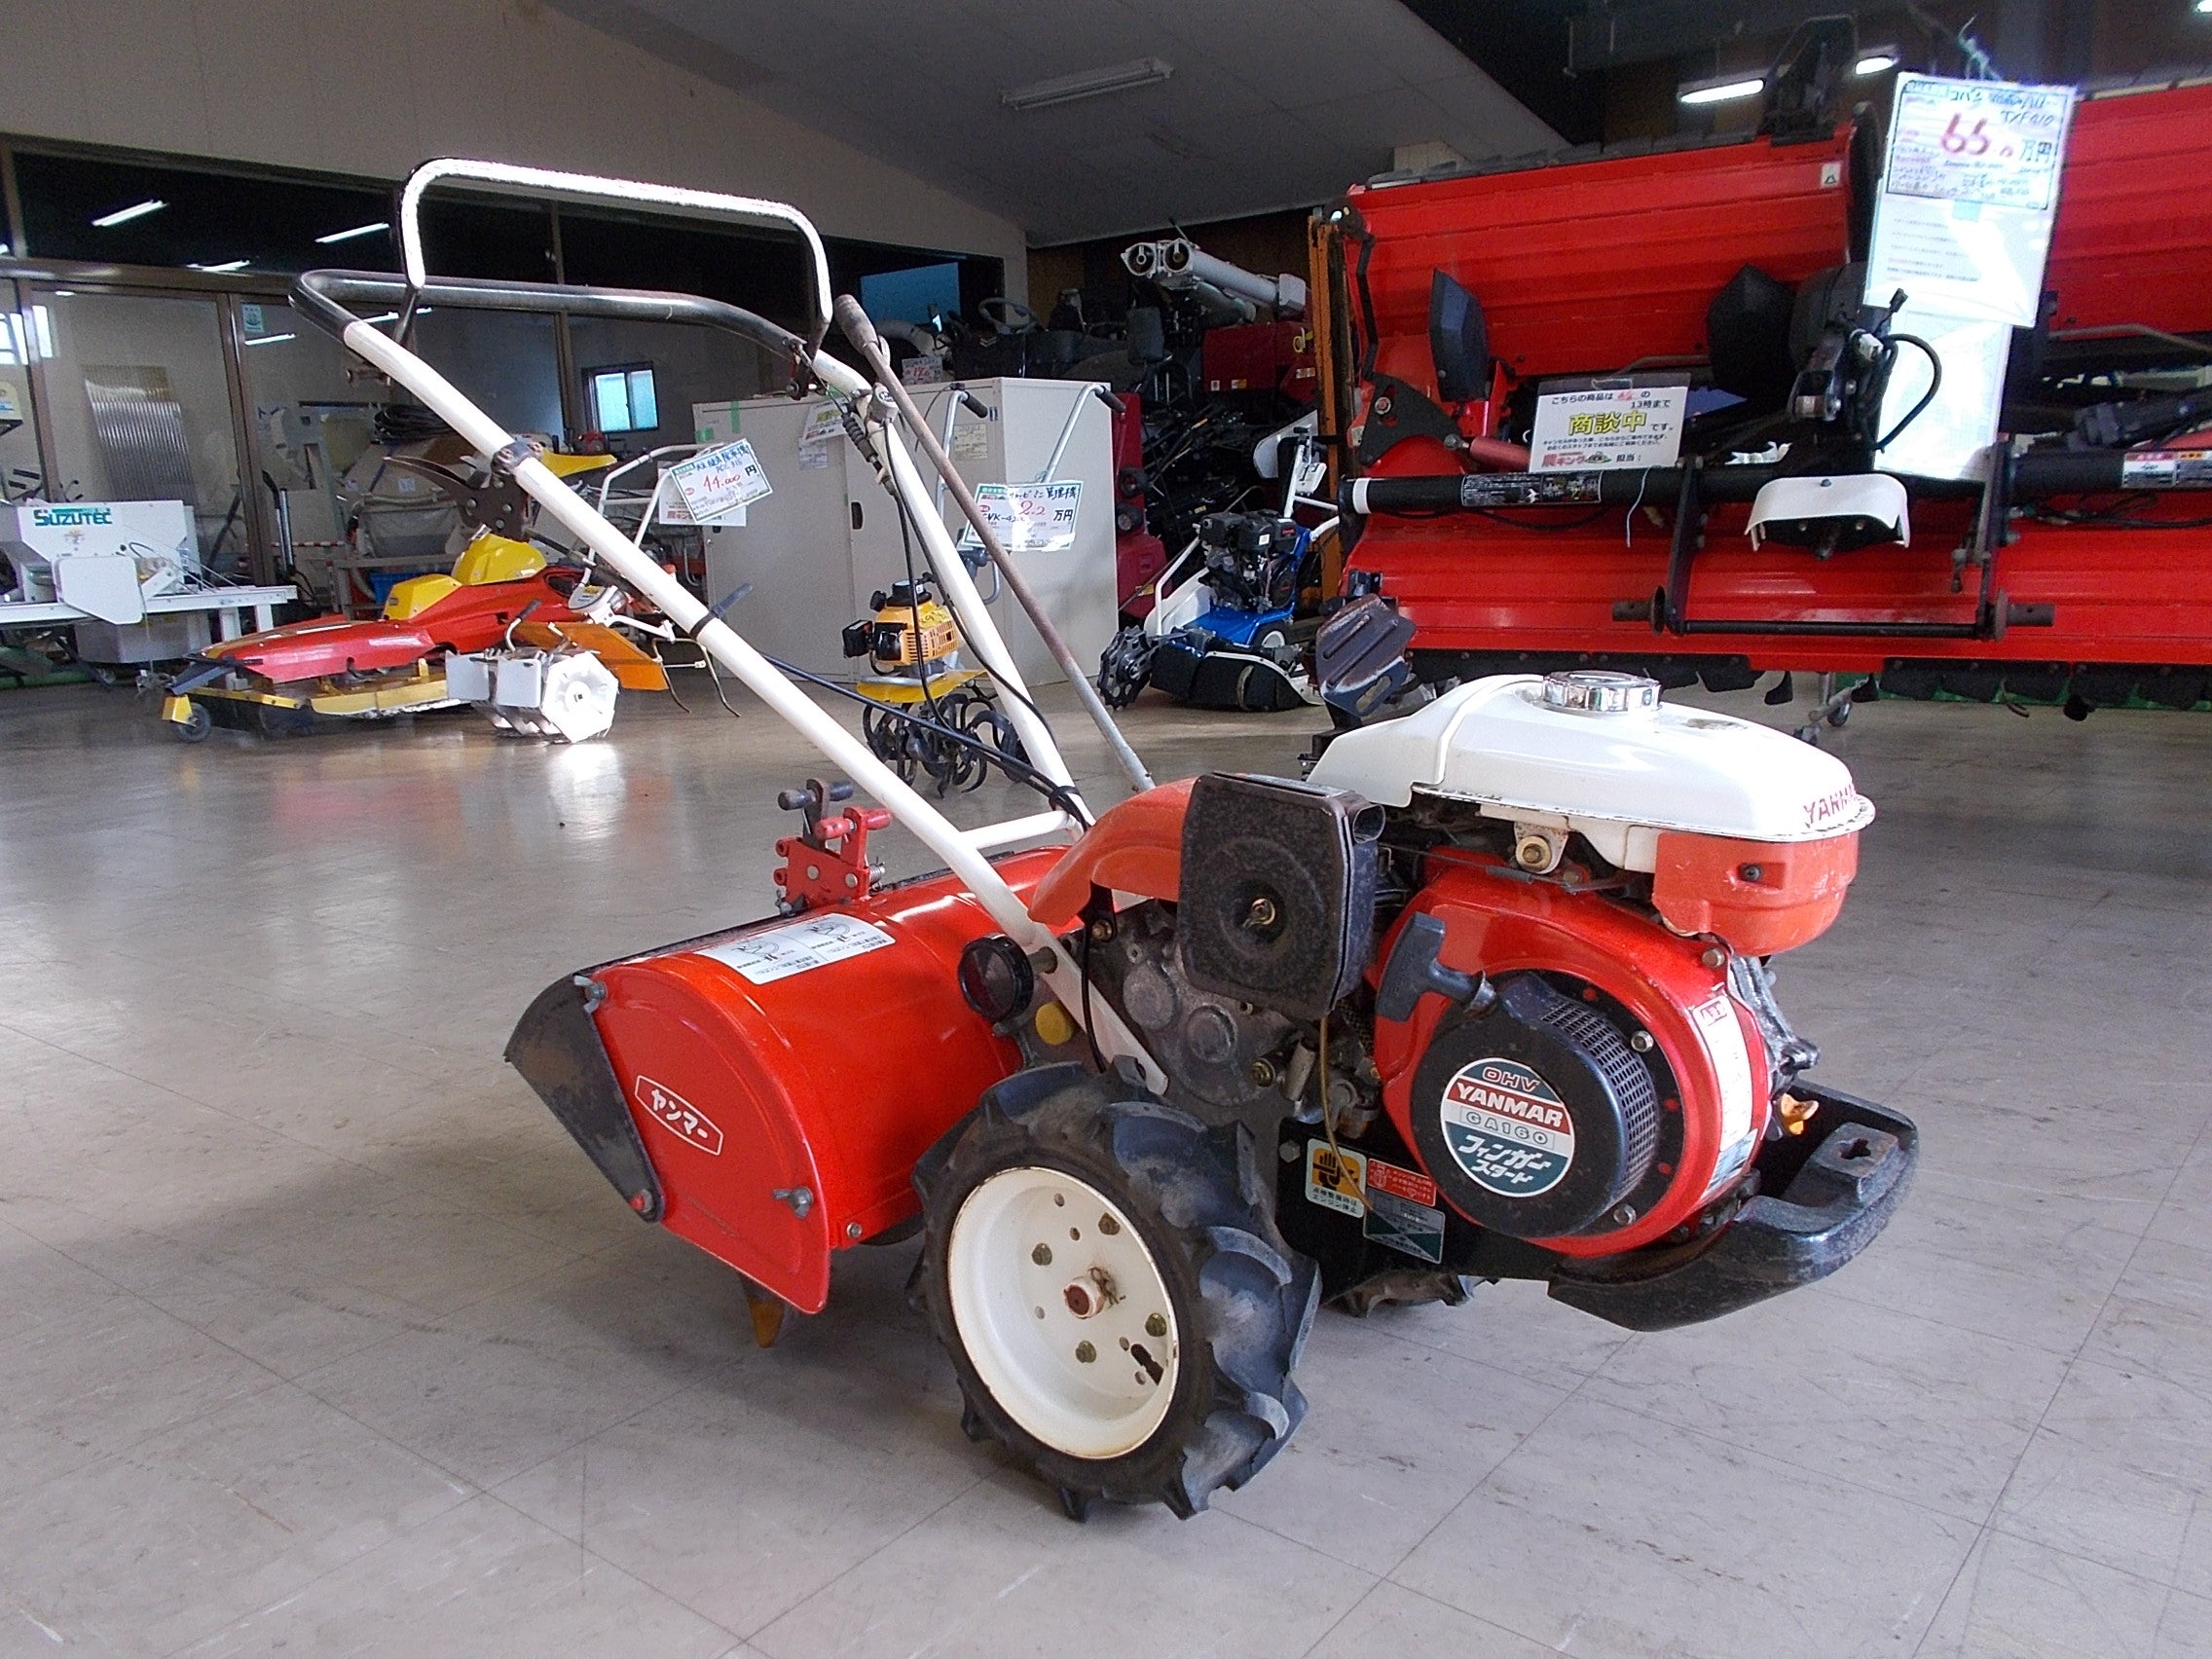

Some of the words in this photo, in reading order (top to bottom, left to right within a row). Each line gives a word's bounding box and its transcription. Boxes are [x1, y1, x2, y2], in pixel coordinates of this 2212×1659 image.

[1552, 392, 1613, 405] こちらの商品は
[1631, 399, 1671, 409] 13時まで
[1568, 410, 1647, 436] 商談中
[744, 464, 757, 476] 円
[33, 508, 113, 526] SUZUTEC
[1018, 499, 1047, 516] 2.2
[1053, 508, 1074, 521] 万円
[1482, 1066, 1541, 1092] OHV
[651, 1089, 708, 1138] ヤンマー
[1457, 1082, 1564, 1127] YANMAR
[1465, 1111, 1548, 1145] GA160
[1457, 1134, 1552, 1170] フィンガー
[1470, 1159, 1534, 1185] スタート
